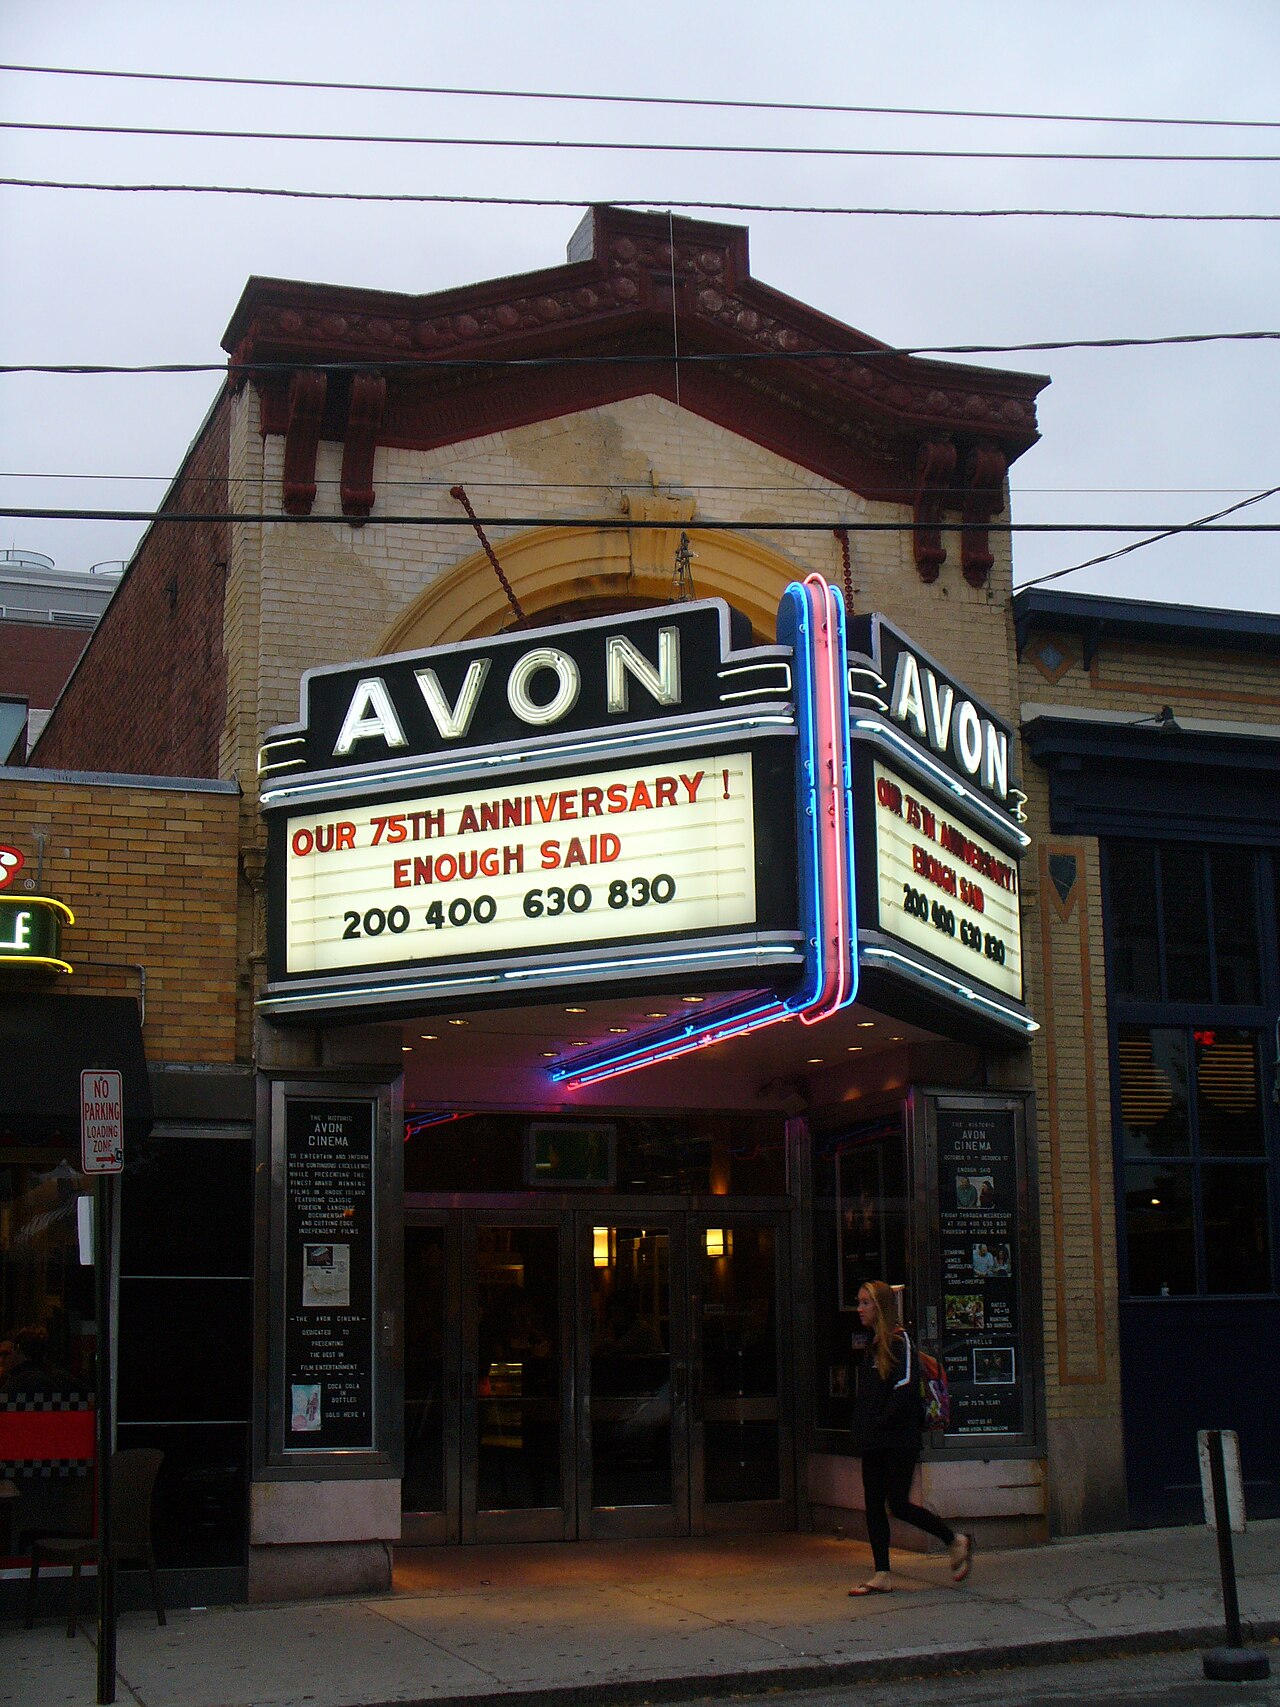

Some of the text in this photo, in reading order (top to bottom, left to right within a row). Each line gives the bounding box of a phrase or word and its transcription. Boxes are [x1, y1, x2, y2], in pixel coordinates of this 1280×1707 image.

[331, 626, 683, 756] AVON
[890, 651, 1008, 800] AVON
[291, 821, 357, 857] OUR
[369, 809, 445, 846] 75TH
[457, 770, 704, 835] ANNIVERSARY
[876, 776, 903, 818] OUR
[905, 794, 936, 841] 75TH
[393, 833, 621, 889] ENOUGH SAID
[912, 843, 985, 913] ENOUGH SAID
[342, 873, 676, 939] 200 400 630 830
[903, 883, 929, 922] 200
[931, 900, 956, 938] 400
[960, 918, 982, 953] 630
[94, 1080, 109, 1098] NO
[85, 1103, 120, 1120] PARKING
[314, 1123, 343, 1133] AVON
[87, 1125, 118, 1138] LOADING
[93, 1140, 112, 1152] ZONE
[308, 1136, 349, 1146] CINEMA
[954, 1141, 991, 1150] CINEMA
[962, 1130, 986, 1139] AVON
